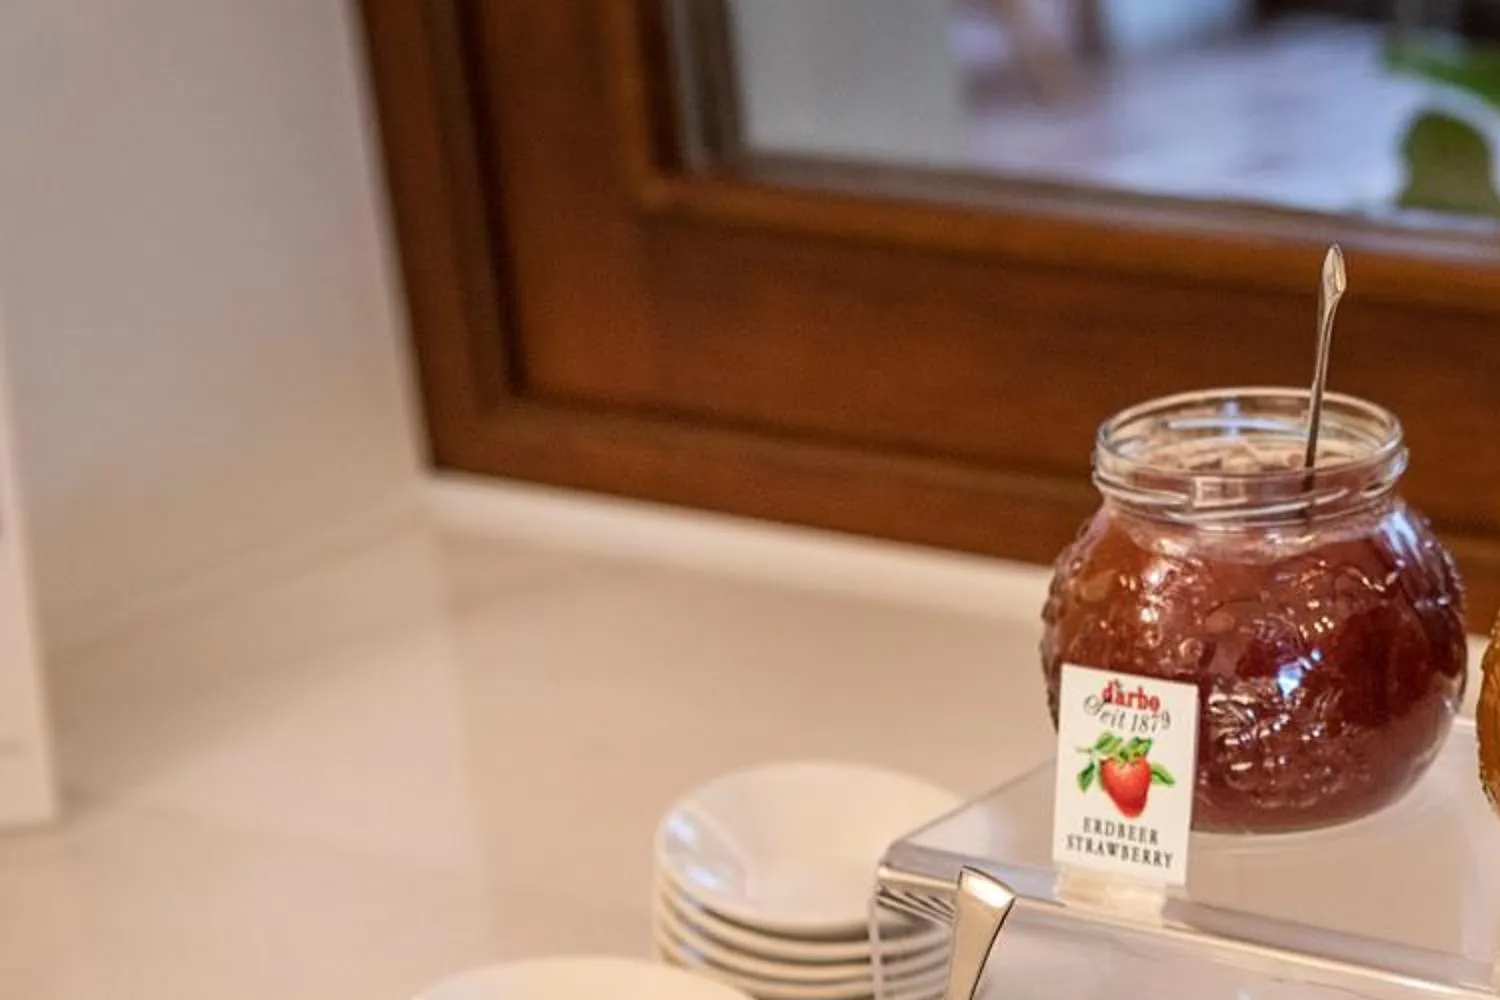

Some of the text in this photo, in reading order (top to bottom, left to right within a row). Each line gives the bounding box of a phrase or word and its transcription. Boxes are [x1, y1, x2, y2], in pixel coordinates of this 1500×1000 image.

[1131, 710, 1171, 733] 1879
[1083, 816, 1159, 845] ERDBEER
[1066, 834, 1173, 869] STRAWBERRY
